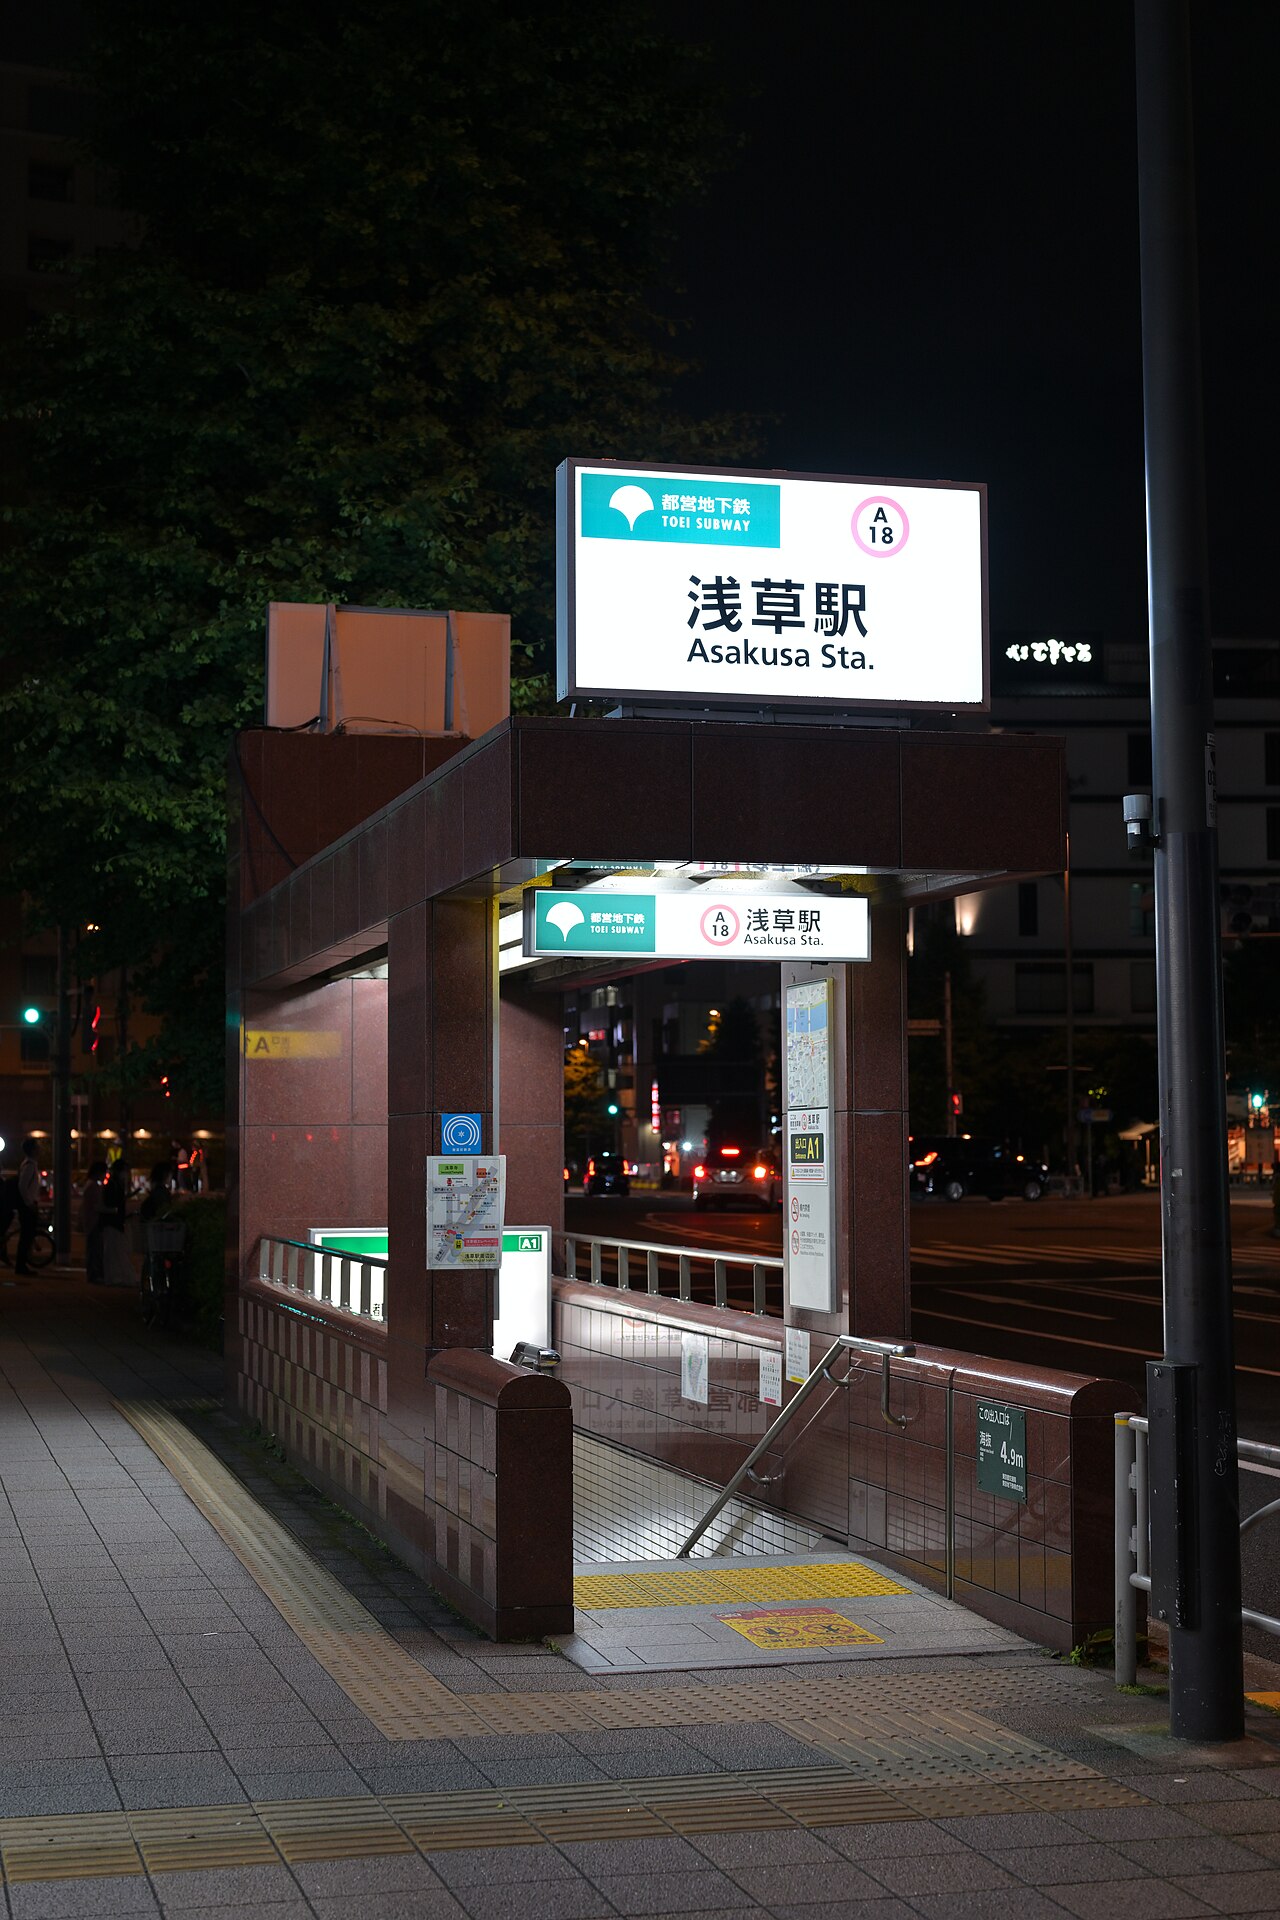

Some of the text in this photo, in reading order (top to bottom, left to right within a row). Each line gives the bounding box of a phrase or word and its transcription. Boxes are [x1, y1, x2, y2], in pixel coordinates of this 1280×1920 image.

[661, 493, 751, 517] 都営地下鉄
[661, 515, 751, 533] TOEI SUBWAY
[873, 507, 888, 524] A
[868, 526, 894, 545] 18
[686, 574, 869, 638] 浅草駅
[686, 638, 875, 671] Asakusa Sta.
[590, 912, 645, 925] 都営地下鉄
[715, 911, 726, 923] A
[745, 907, 822, 933] 浅草駅
[590, 925, 645, 936] TOEI SUBWAY
[711, 924, 730, 937] 18
[743, 932, 824, 947] Asakusa Sta.
[807, 1136, 820, 1160] A1
[521, 1238, 537, 1249] A1
[979, 1407, 1010, 1425] この出入口は
[1000, 1441, 1023, 1468] 4.9m
